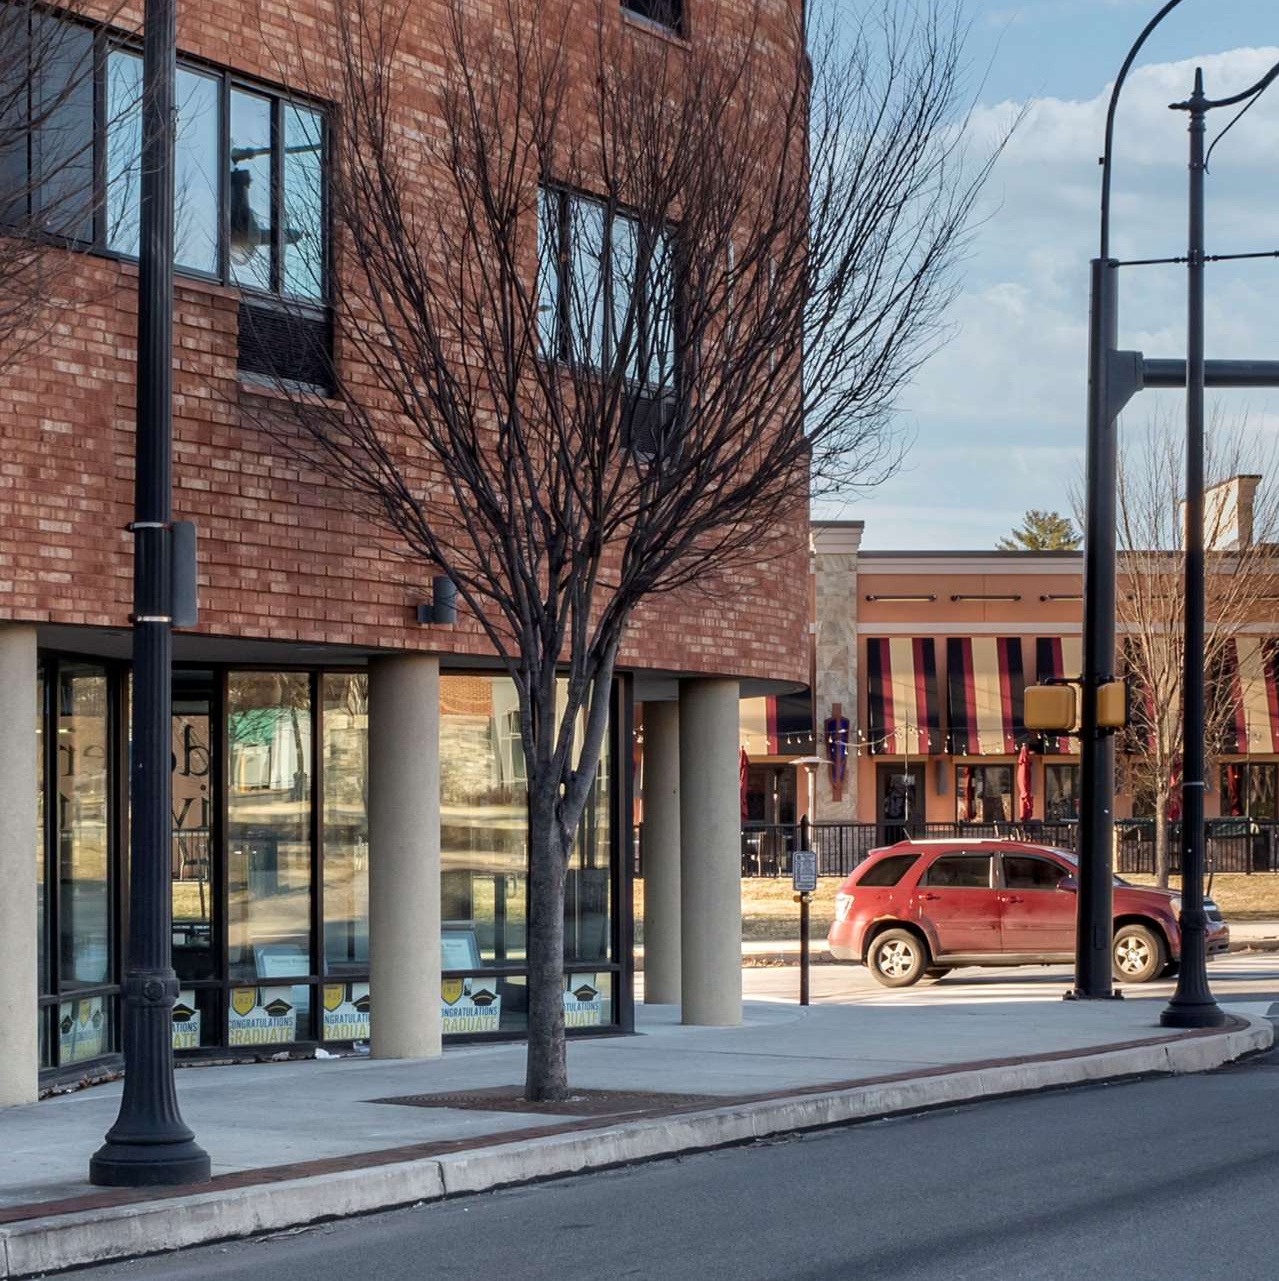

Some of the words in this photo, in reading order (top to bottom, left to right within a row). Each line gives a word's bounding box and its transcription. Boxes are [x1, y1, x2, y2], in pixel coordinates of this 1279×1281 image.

[324, 1013, 368, 1023] NGRATULATI
[442, 1016, 496, 1032] RADUATE
[324, 1022, 367, 1039] RADUA
